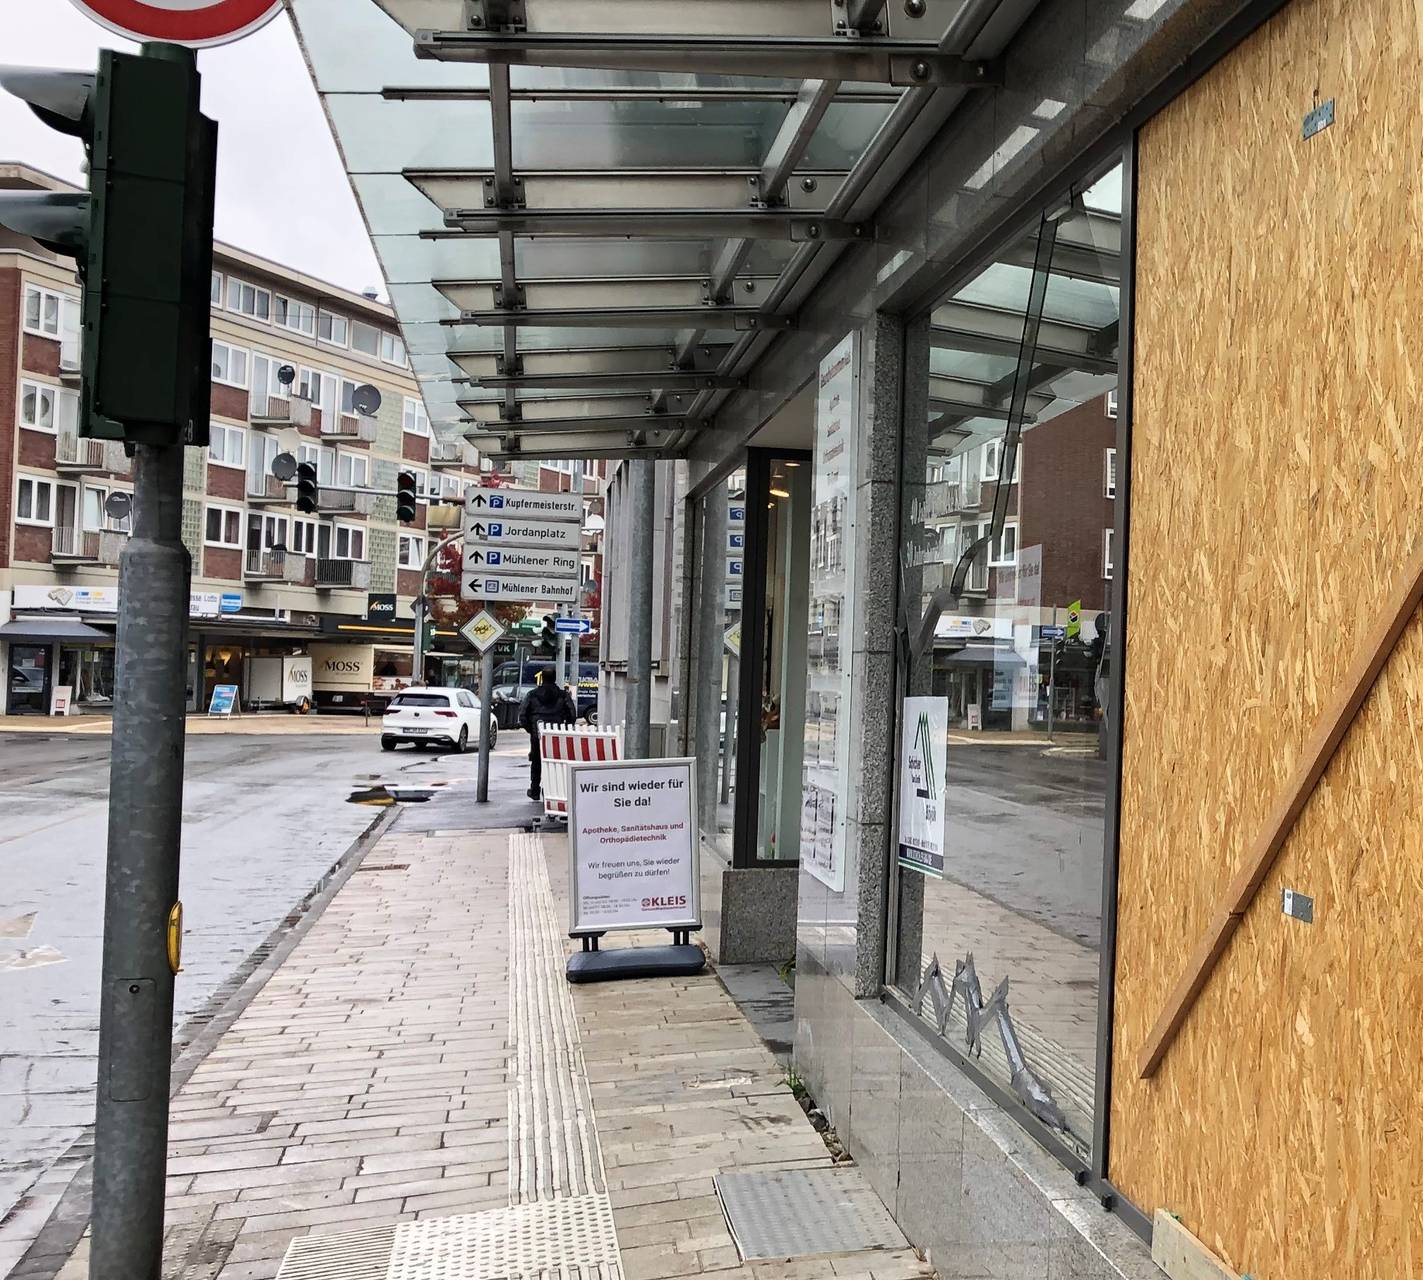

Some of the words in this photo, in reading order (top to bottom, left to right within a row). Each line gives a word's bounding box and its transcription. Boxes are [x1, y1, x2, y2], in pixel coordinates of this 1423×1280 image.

[505, 498, 577, 512] Kupfermeisterstr.
[504, 526, 567, 539] Jordanplatz
[502, 554, 549, 567] Mühlener
[553, 556, 575, 570] Ring
[501, 582, 538, 594] Mühlener
[541, 584, 573, 596] Bahnhof
[371, 602, 394, 611] MOSS
[324, 660, 361, 672] MOSS
[580, 782, 599, 793] Wir
[602, 780, 625, 792] sind
[628, 779, 665, 791] wieder
[668, 778, 684, 790] für
[614, 797, 631, 808] Sie
[634, 797, 651, 807] da!
[582, 825, 619, 835] Apotheke,
[621, 823, 668, 834] Sanitätshaus
[670, 822, 684, 831] und
[600, 834, 667, 845] Orthopädietechnik
[588, 861, 600, 870] Wir
[601, 860, 625, 869] freuen
[643, 858, 655, 866] Sie
[656, 857, 680, 866] wieder
[598, 870, 633, 881] begrüßen
[644, 868, 670, 877] dürfen!
[651, 895, 687, 907] KLEIS
